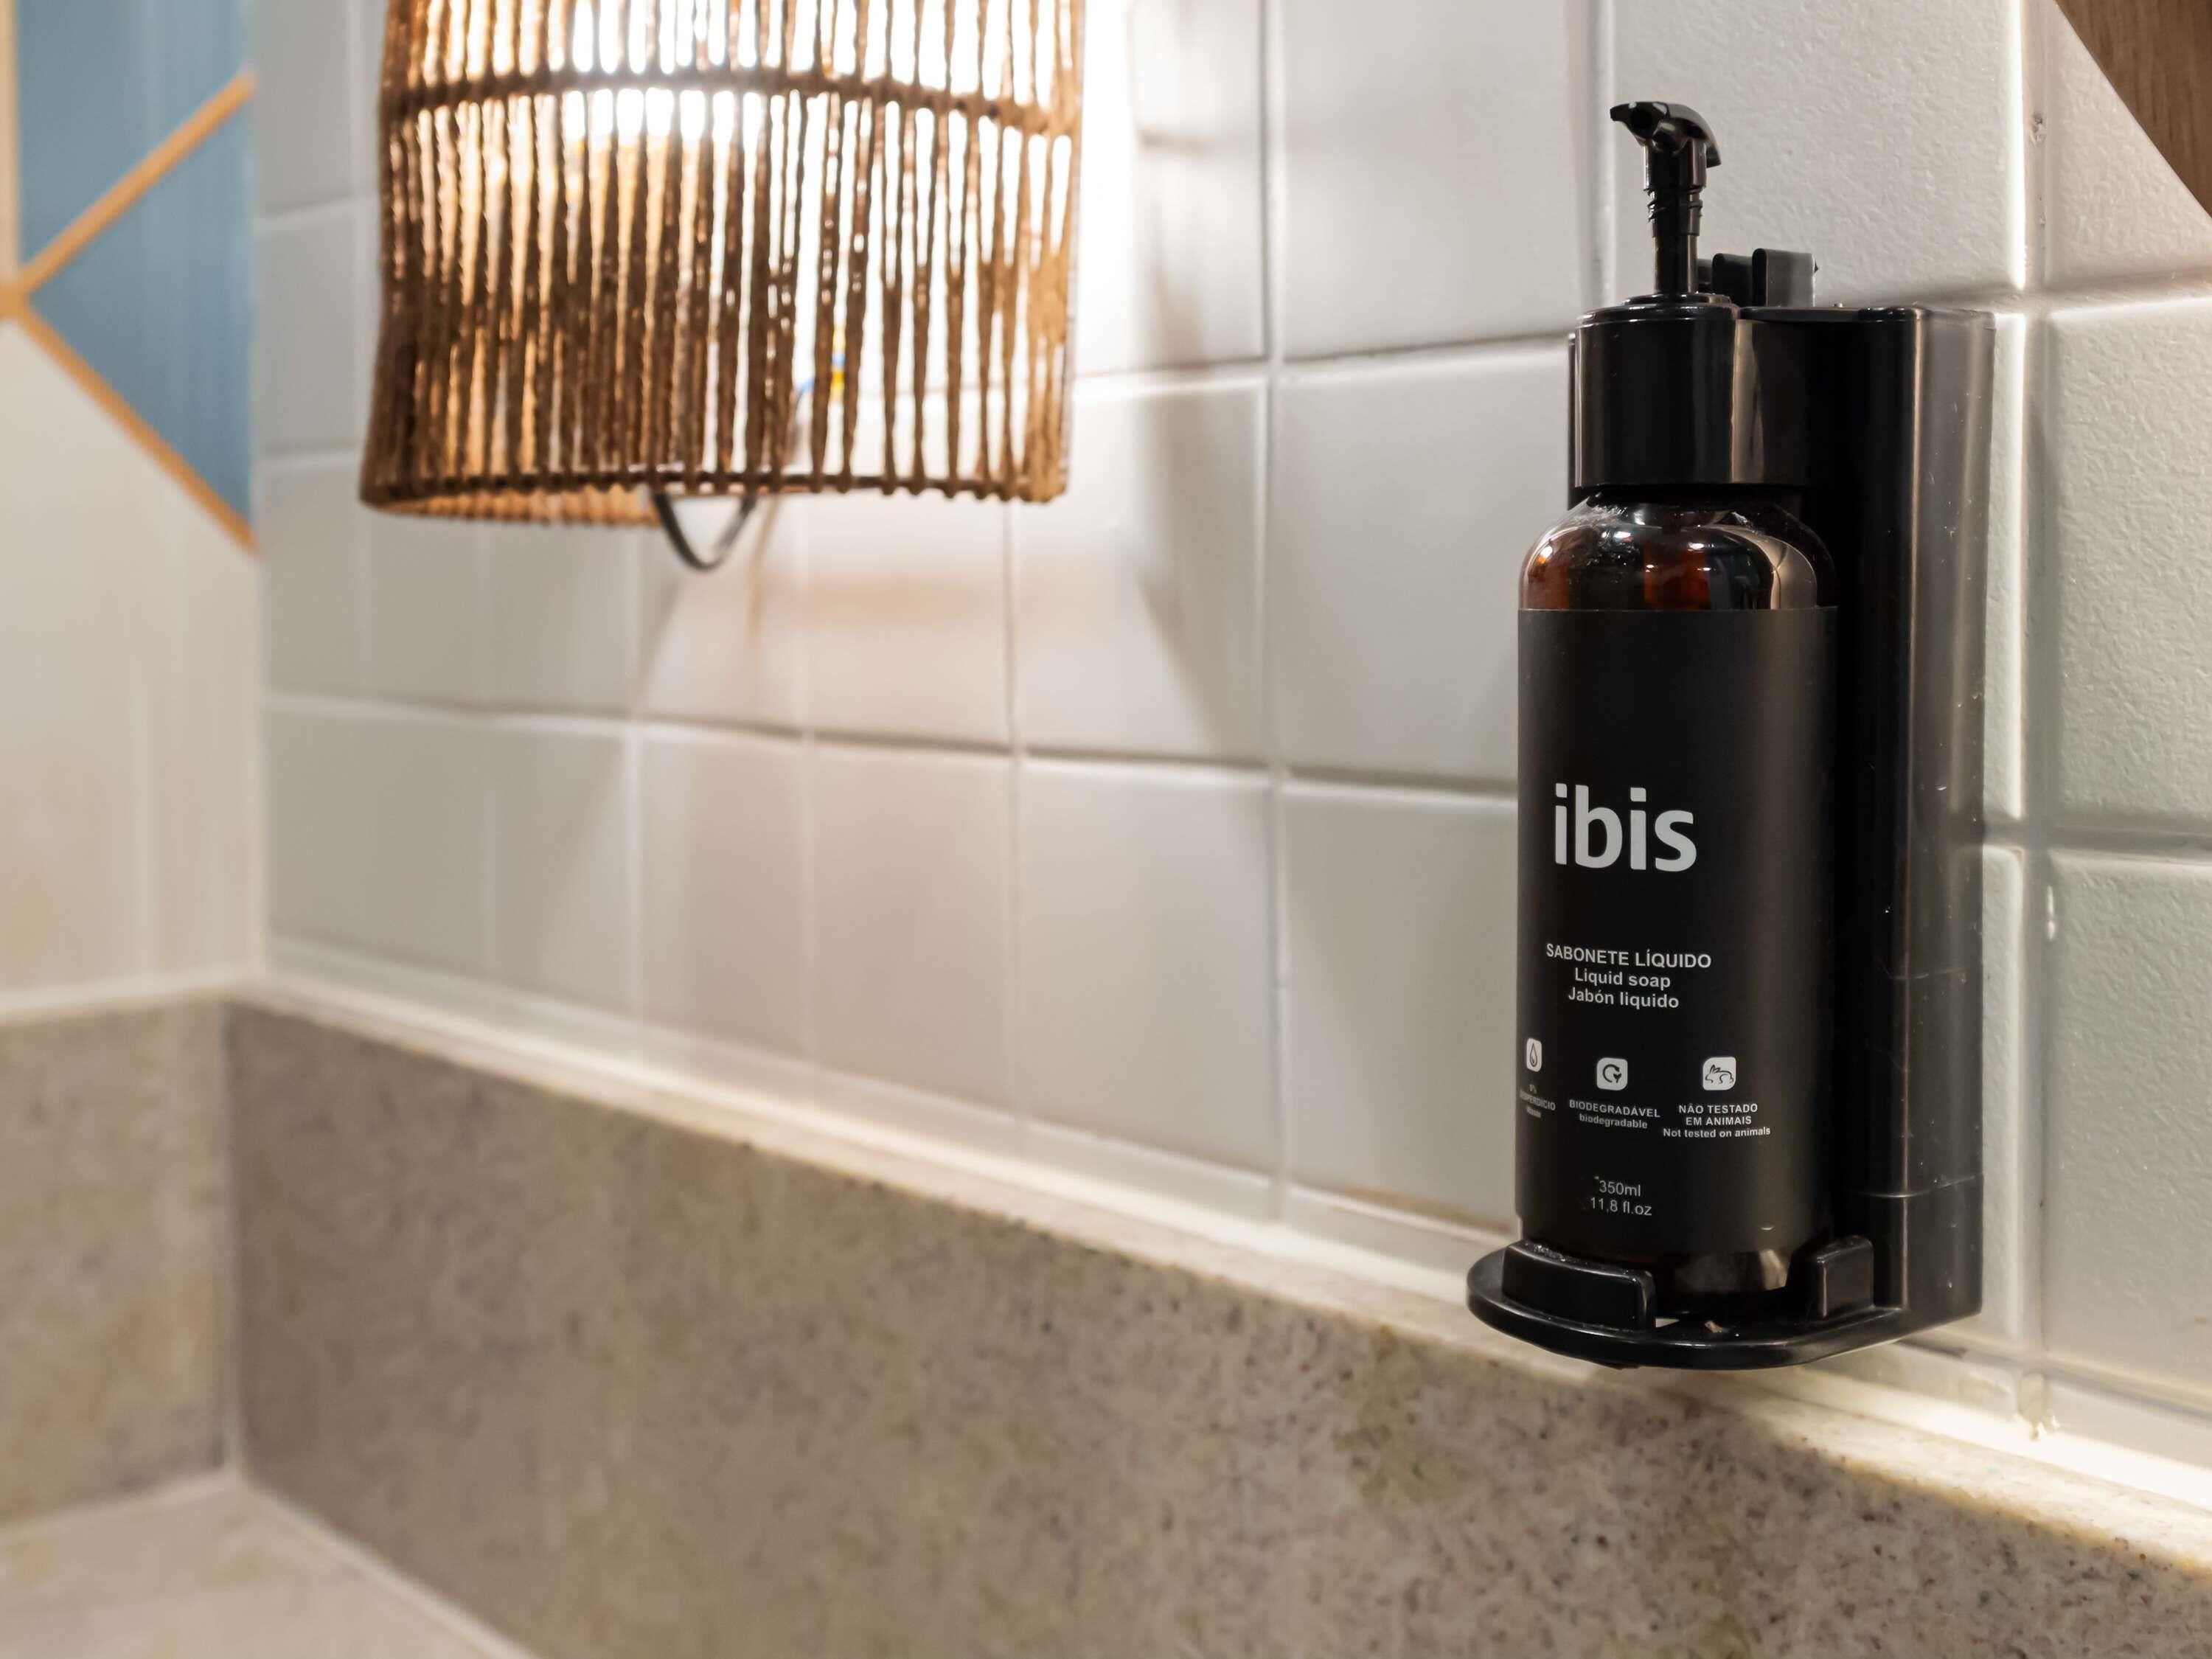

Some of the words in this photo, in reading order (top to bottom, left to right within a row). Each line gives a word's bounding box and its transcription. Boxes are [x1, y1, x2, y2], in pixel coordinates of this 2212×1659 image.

[1555, 783, 1697, 872] ibis
[1546, 943, 1630, 966] SABONETE
[1635, 949, 1711, 968] LÍQUIDO
[1575, 967, 1623, 986] Liquid
[1628, 975, 1671, 990] soap
[1568, 987, 1614, 1004] Jabón
[1569, 1099, 1660, 1118] BIODEGRADÁVEL
[1679, 1103, 1704, 1113] NÃO
[1707, 1103, 1759, 1114] TESTADO
[1579, 1113, 1648, 1129] biodegradable
[1686, 1117, 1702, 1126] EM
[1705, 1116, 1752, 1126] ANIMAIS
[1663, 1128, 1681, 1137] Not
[1685, 1129, 1716, 1138] tested
[1735, 1127, 1771, 1137] animals
[1599, 1180, 1641, 1197] 350ml
[1623, 1200, 1652, 1216] fl.oz
